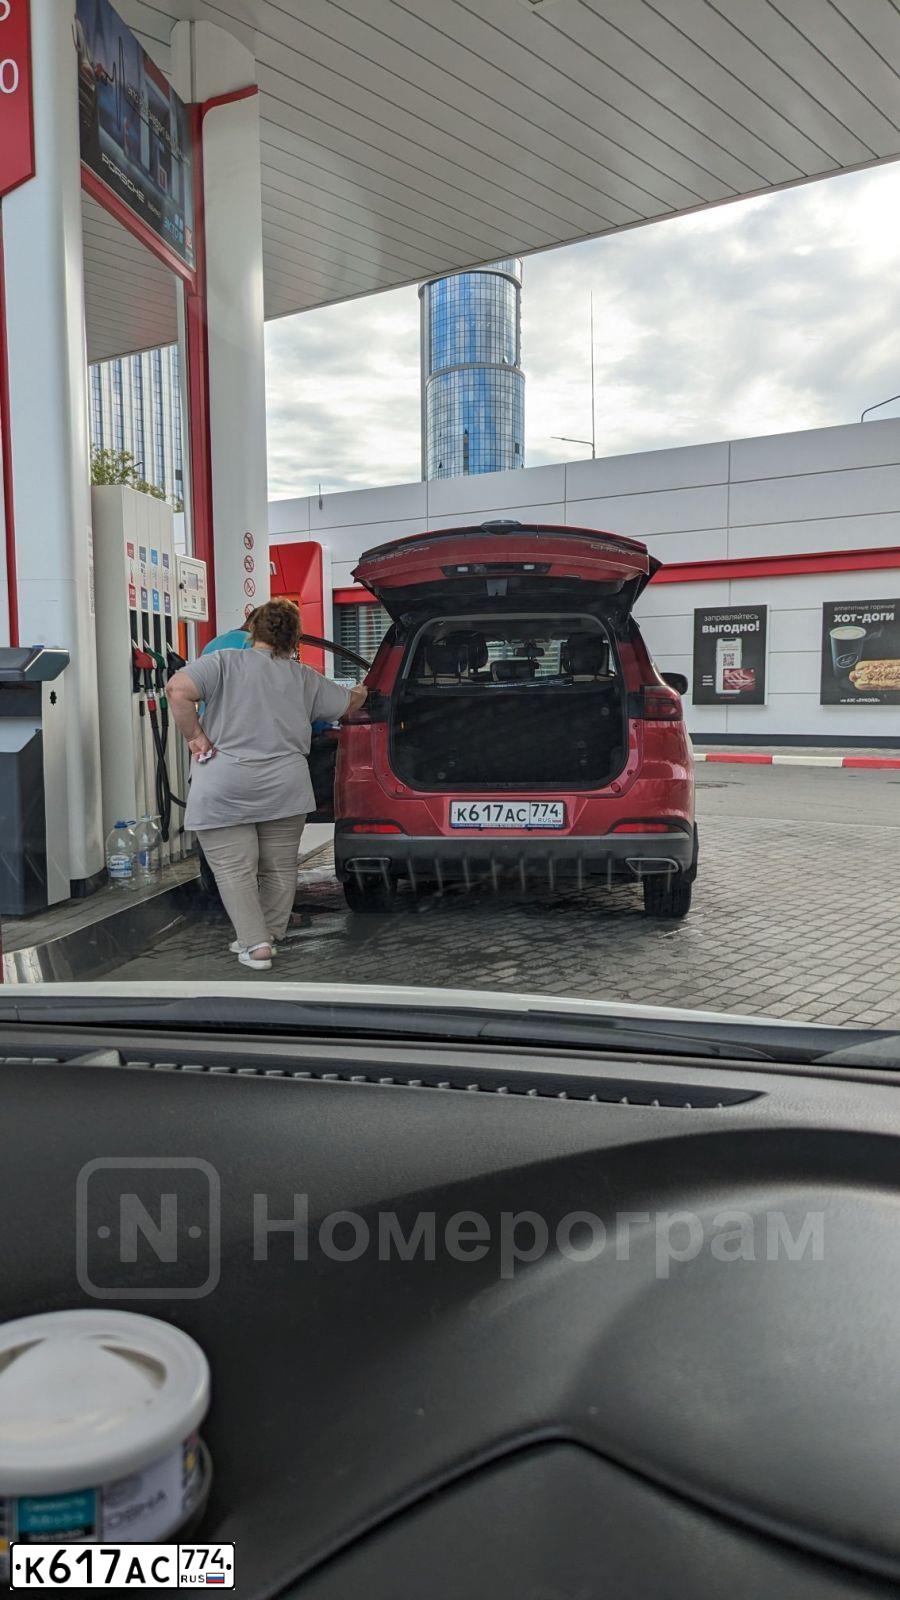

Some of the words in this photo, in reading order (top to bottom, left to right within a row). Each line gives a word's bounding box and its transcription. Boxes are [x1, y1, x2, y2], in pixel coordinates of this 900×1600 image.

[102, 153, 145, 203] PORSCHE
[704, 613, 760, 622] заправляйтесь
[833, 612, 895, 624] хот-доги
[702, 620, 761, 634] выгодно!
[531, 803, 559, 817] 774
